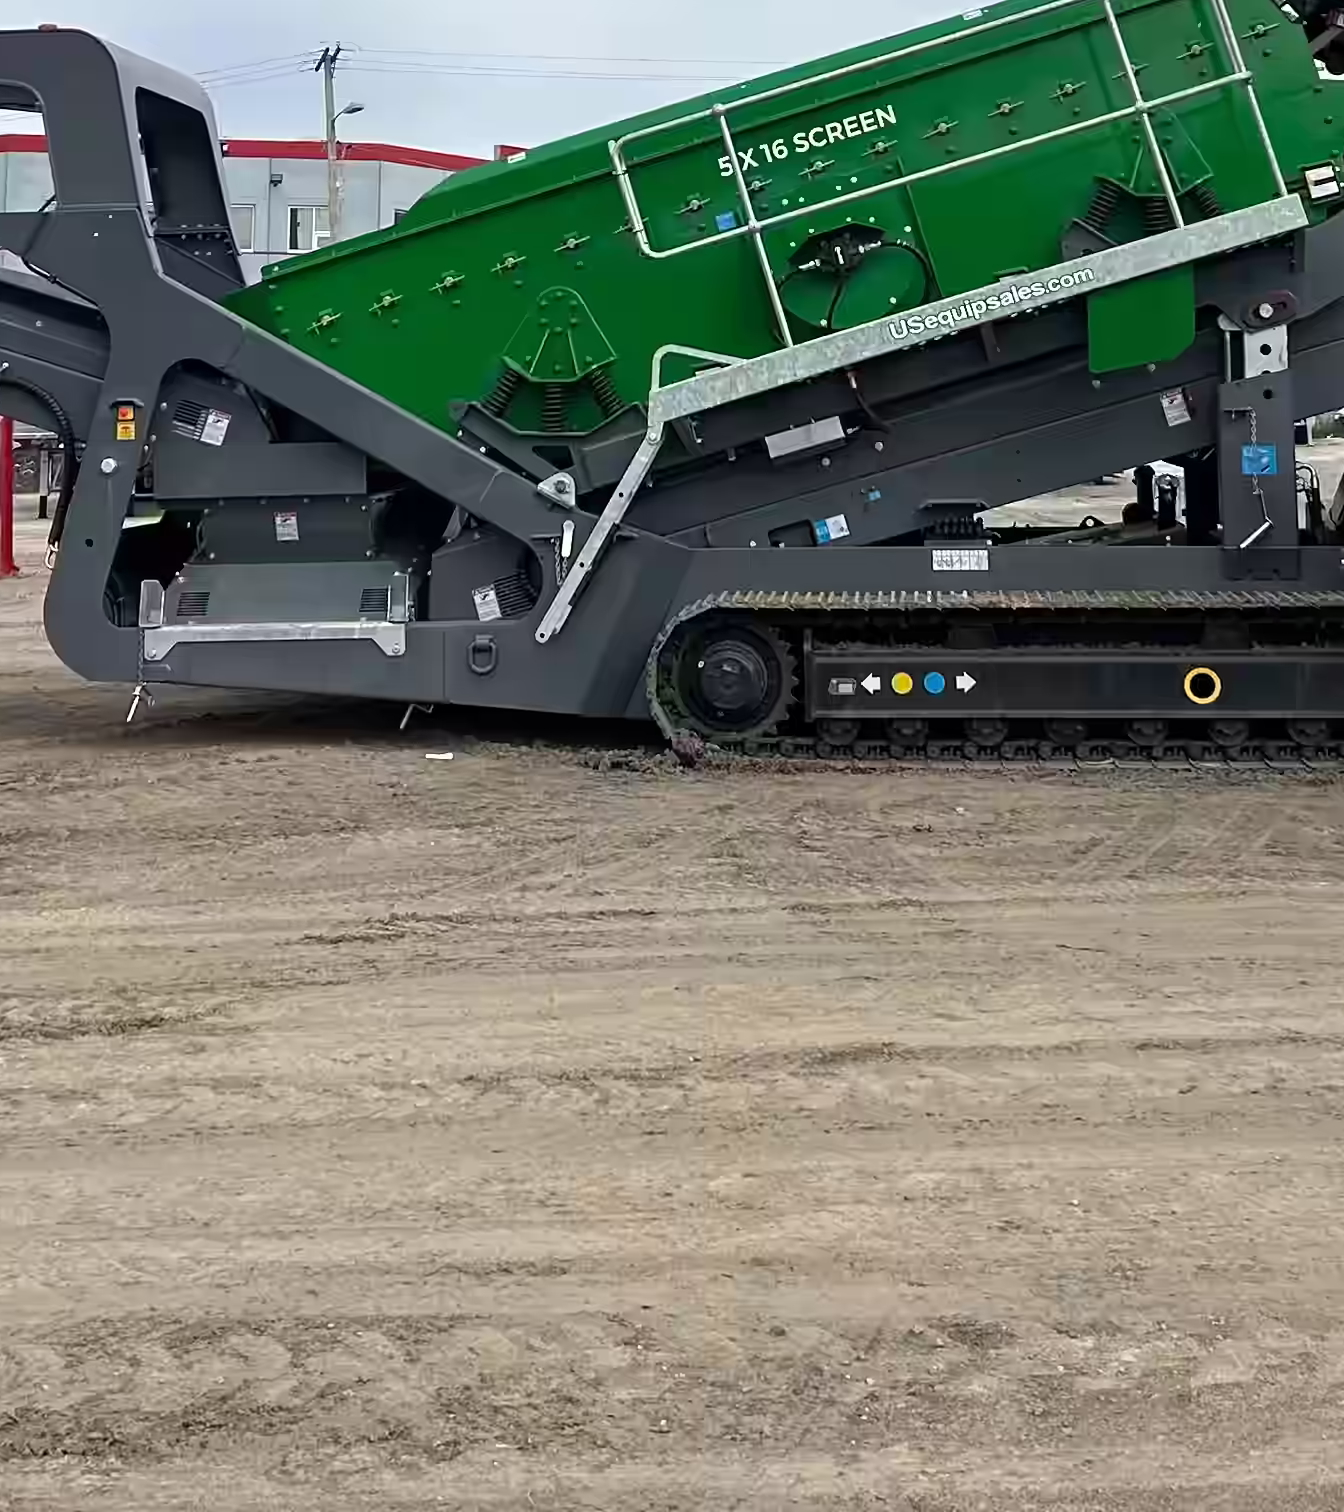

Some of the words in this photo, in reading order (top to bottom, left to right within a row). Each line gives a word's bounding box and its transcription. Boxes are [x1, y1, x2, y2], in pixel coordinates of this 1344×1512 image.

[717, 155, 734, 178] 5
[737, 147, 760, 172] X
[759, 138, 789, 164] 16
[792, 104, 898, 154] SCREEN
[887, 267, 1096, 340] USequipsales.com
